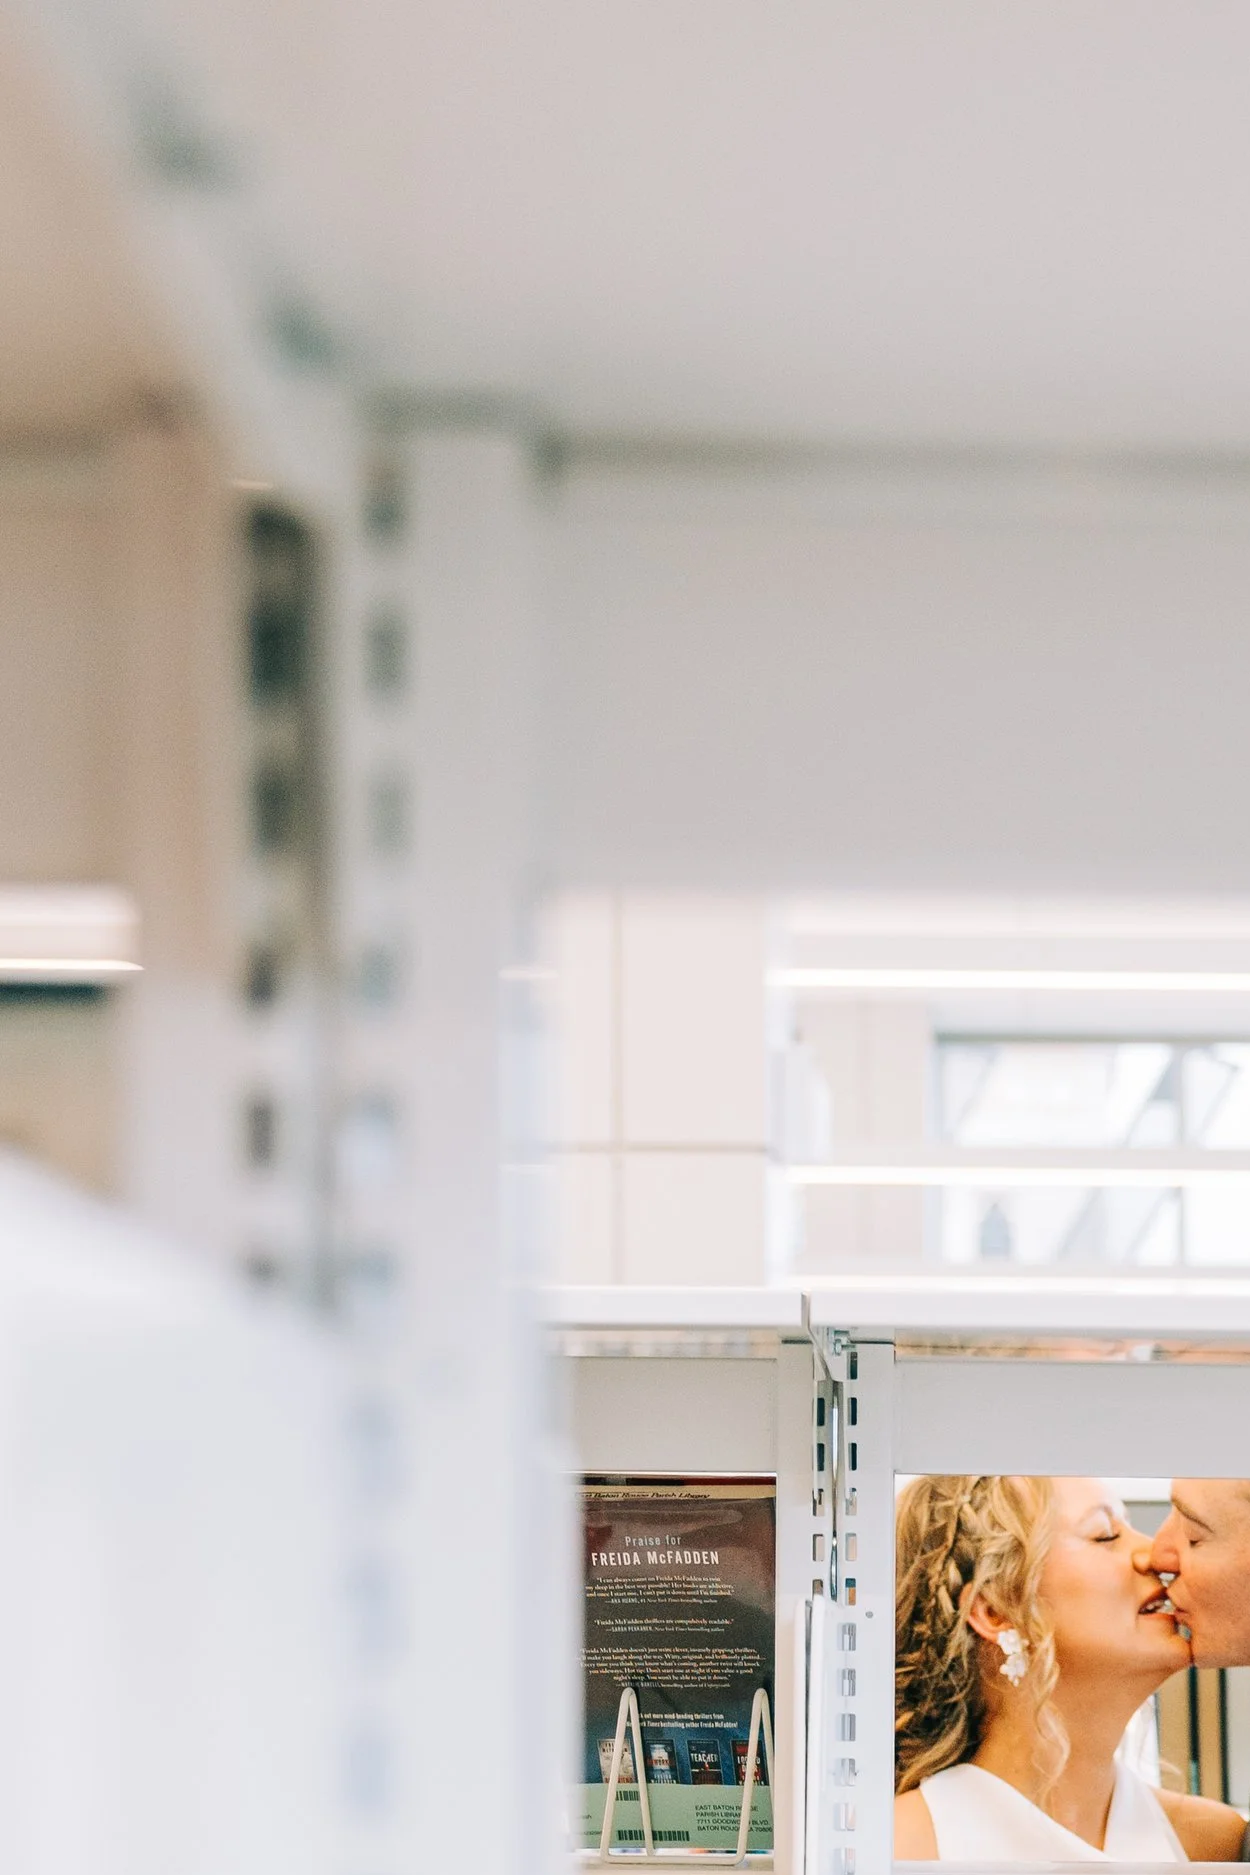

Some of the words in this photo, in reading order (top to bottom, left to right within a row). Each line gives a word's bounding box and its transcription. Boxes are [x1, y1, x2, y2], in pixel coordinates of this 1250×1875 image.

[625, 1536, 661, 1547] Praise
[665, 1534, 681, 1546] for
[592, 1552, 641, 1566] FREIDA
[647, 1551, 719, 1565] McFADDEN
